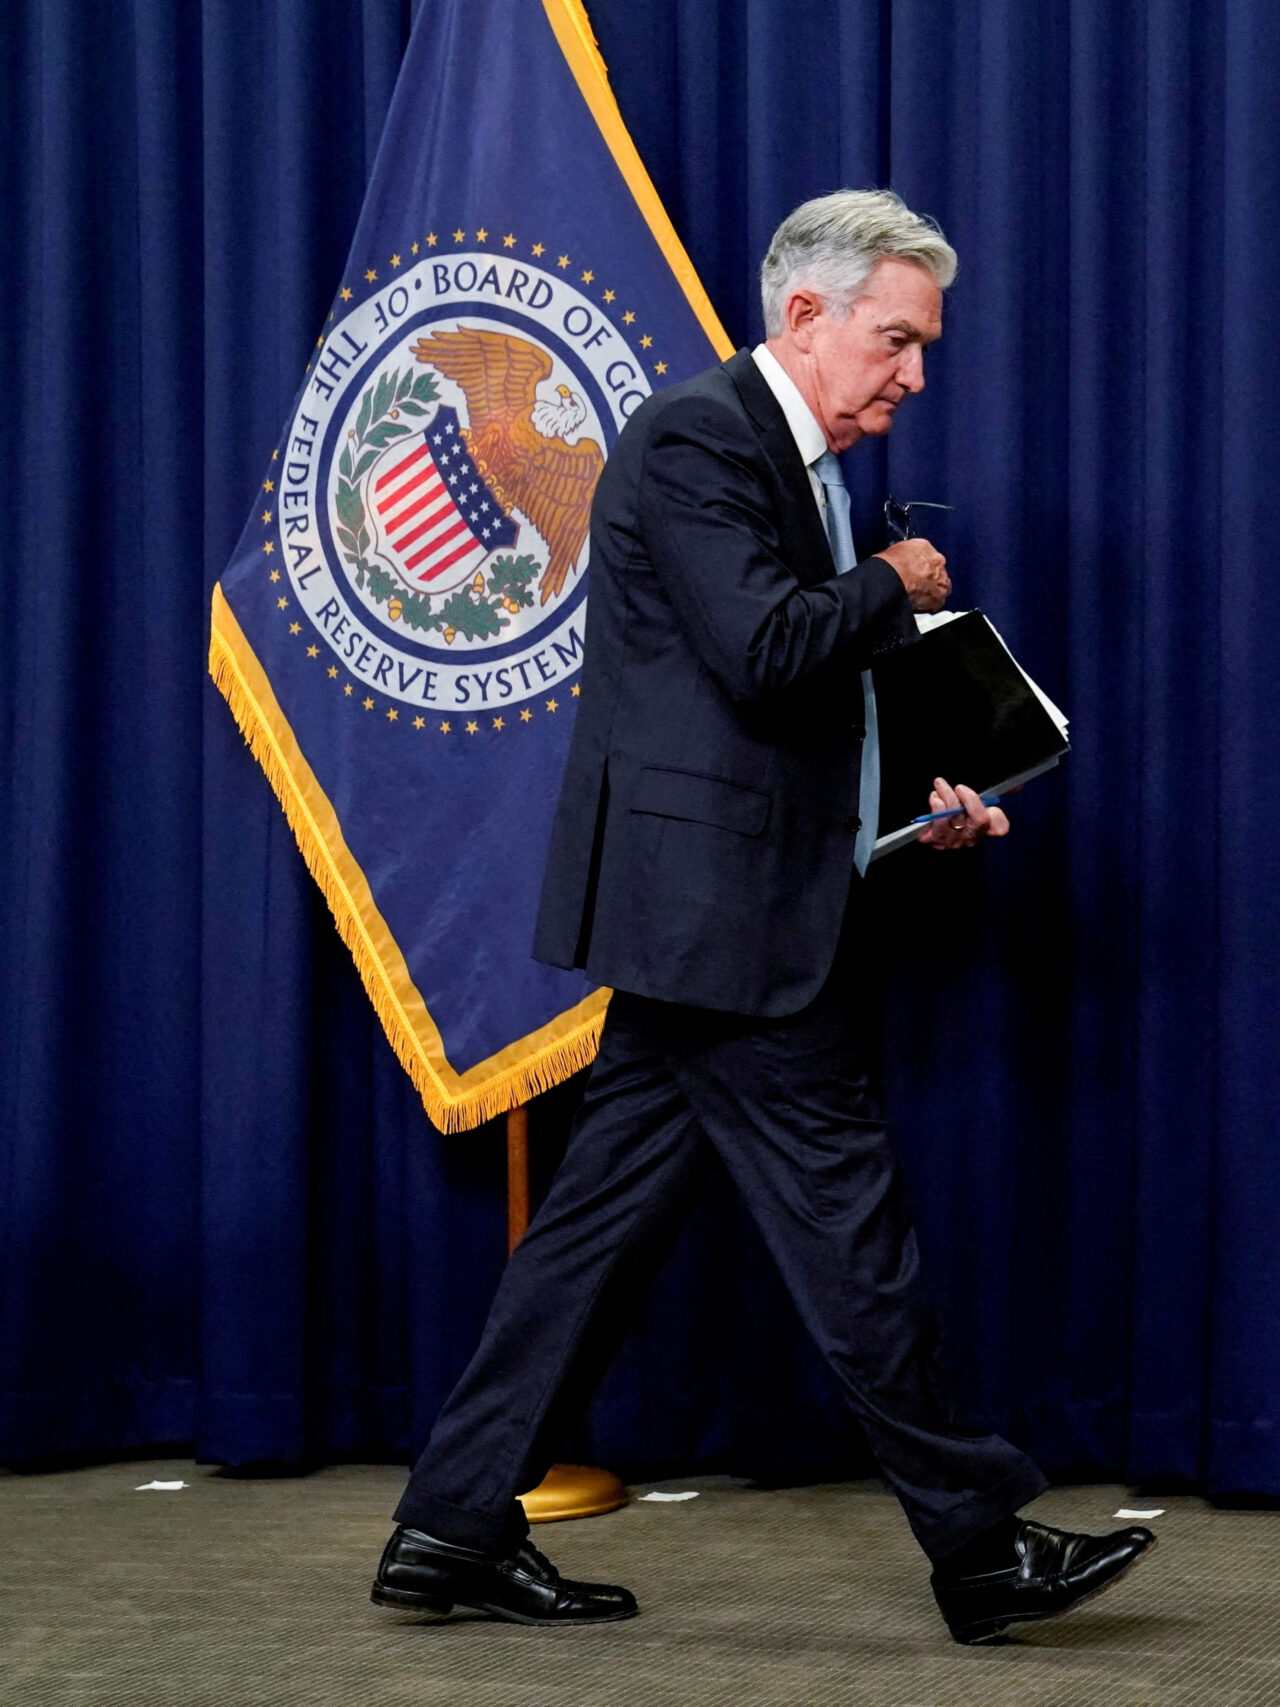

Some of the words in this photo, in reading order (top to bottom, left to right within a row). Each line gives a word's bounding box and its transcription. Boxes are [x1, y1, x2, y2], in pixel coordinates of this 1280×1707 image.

[374, 286, 409, 335] OF
[433, 261, 553, 310] BOARD
[563, 305, 613, 350] OF
[310, 329, 368, 403] THE
[284, 413, 322, 591] FEDERAL
[316, 596, 438, 702] RESERVE
[454, 626, 585, 703] SYSTEM
